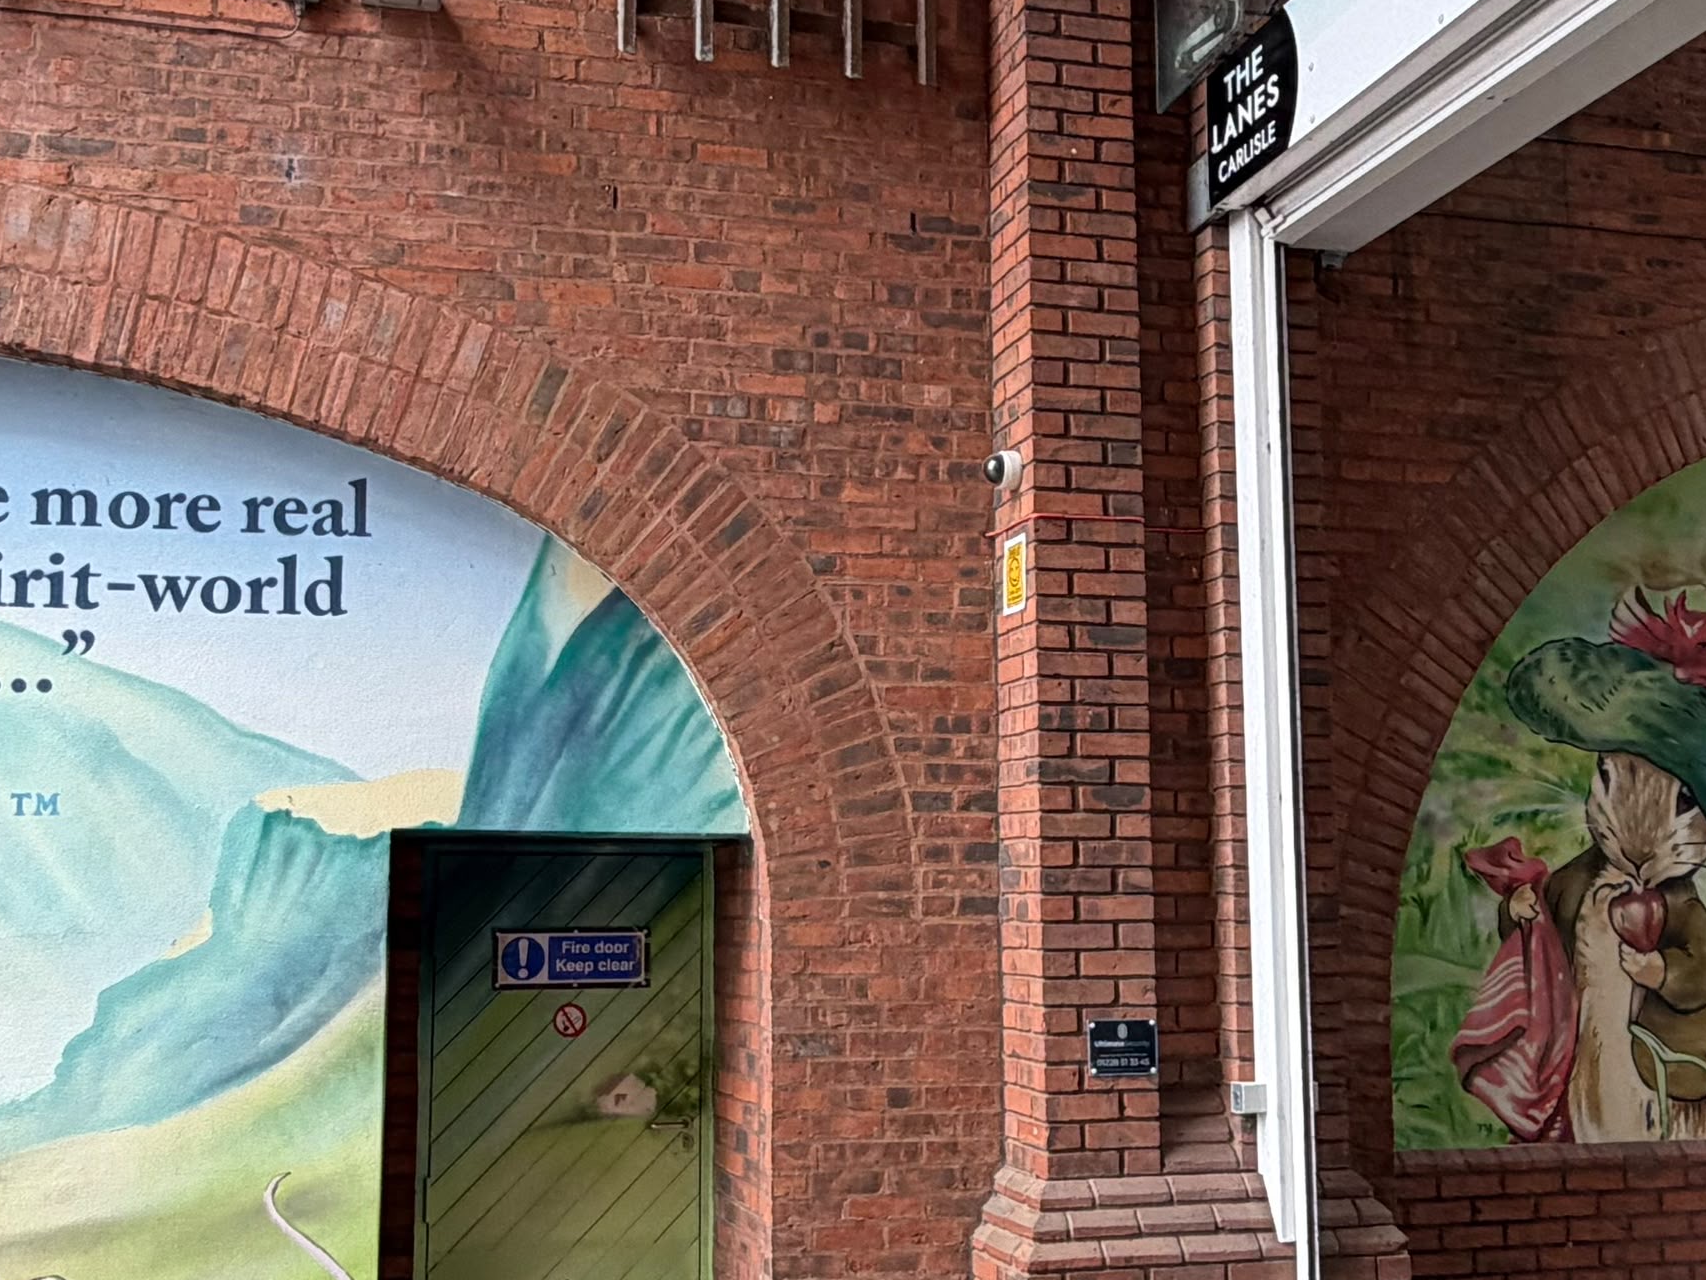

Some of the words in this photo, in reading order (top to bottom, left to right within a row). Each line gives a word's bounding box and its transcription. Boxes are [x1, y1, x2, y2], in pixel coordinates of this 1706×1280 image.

[1223, 44, 1263, 103] THE
[1211, 73, 1280, 154] LANES
[1218, 120, 1276, 183] CARLISLE
[30, 487, 222, 533] more
[240, 478, 371, 538] real
[10, 792, 62, 817] TM
[555, 959, 594, 975] Keep
[598, 959, 634, 972] clear
[562, 941, 591, 954] Fire
[595, 942, 629, 954] door
